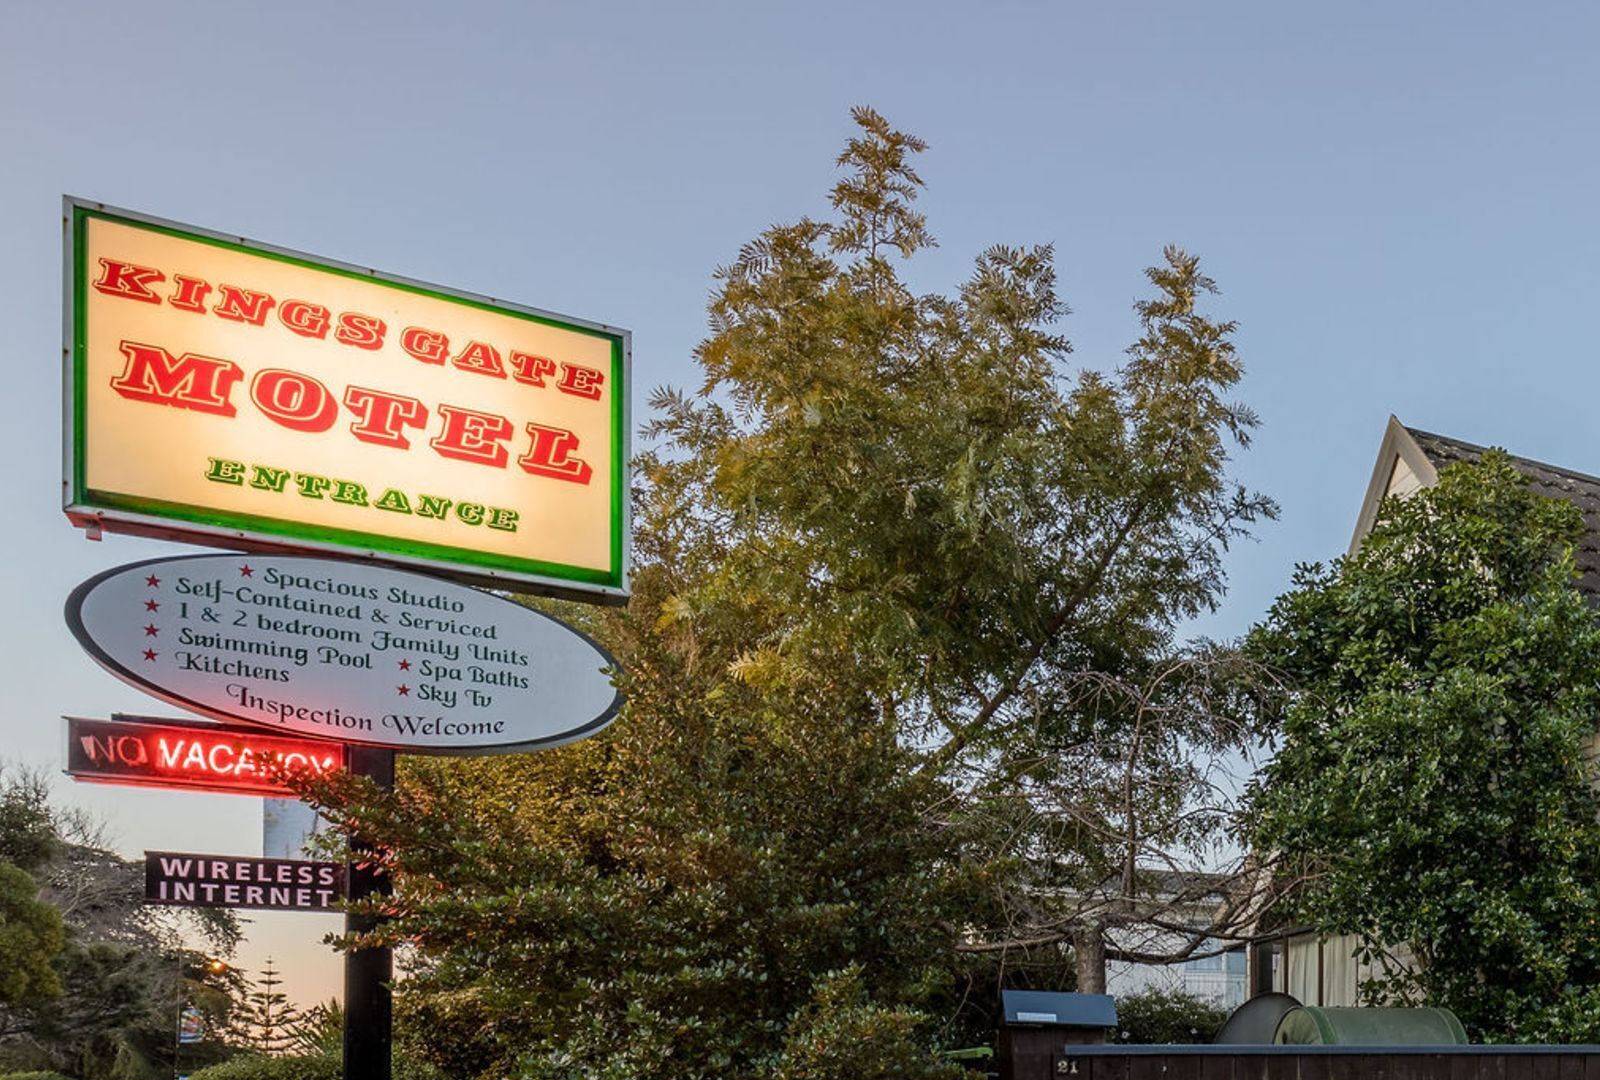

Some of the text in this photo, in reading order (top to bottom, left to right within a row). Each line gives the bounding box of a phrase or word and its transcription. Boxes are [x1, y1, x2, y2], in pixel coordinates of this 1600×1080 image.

[92, 257, 605, 401] KINGS GATE
[110, 340, 593, 486] MOTEL
[205, 456, 520, 532] ENTRANCE
[175, 577, 497, 640] Self-Contained & Serviced
[263, 567, 465, 613] Spacious Studio
[178, 627, 373, 670] Swimming Pool
[201, 607, 221, 623] &
[232, 609, 248, 627] 2
[257, 614, 362, 643] bedroom
[371, 630, 460, 661] Family
[467, 643, 529, 666] Units
[174, 651, 290, 682] Kitchens
[419, 659, 529, 689] Spa Baths
[226, 683, 505, 737] Inspection Welcome
[417, 684, 457, 708] Sky
[80, 734, 149, 767] NO
[160, 857, 335, 886] WIRELESS
[159, 881, 335, 908] INTERNET
[1056, 1060, 1079, 1074] 21
